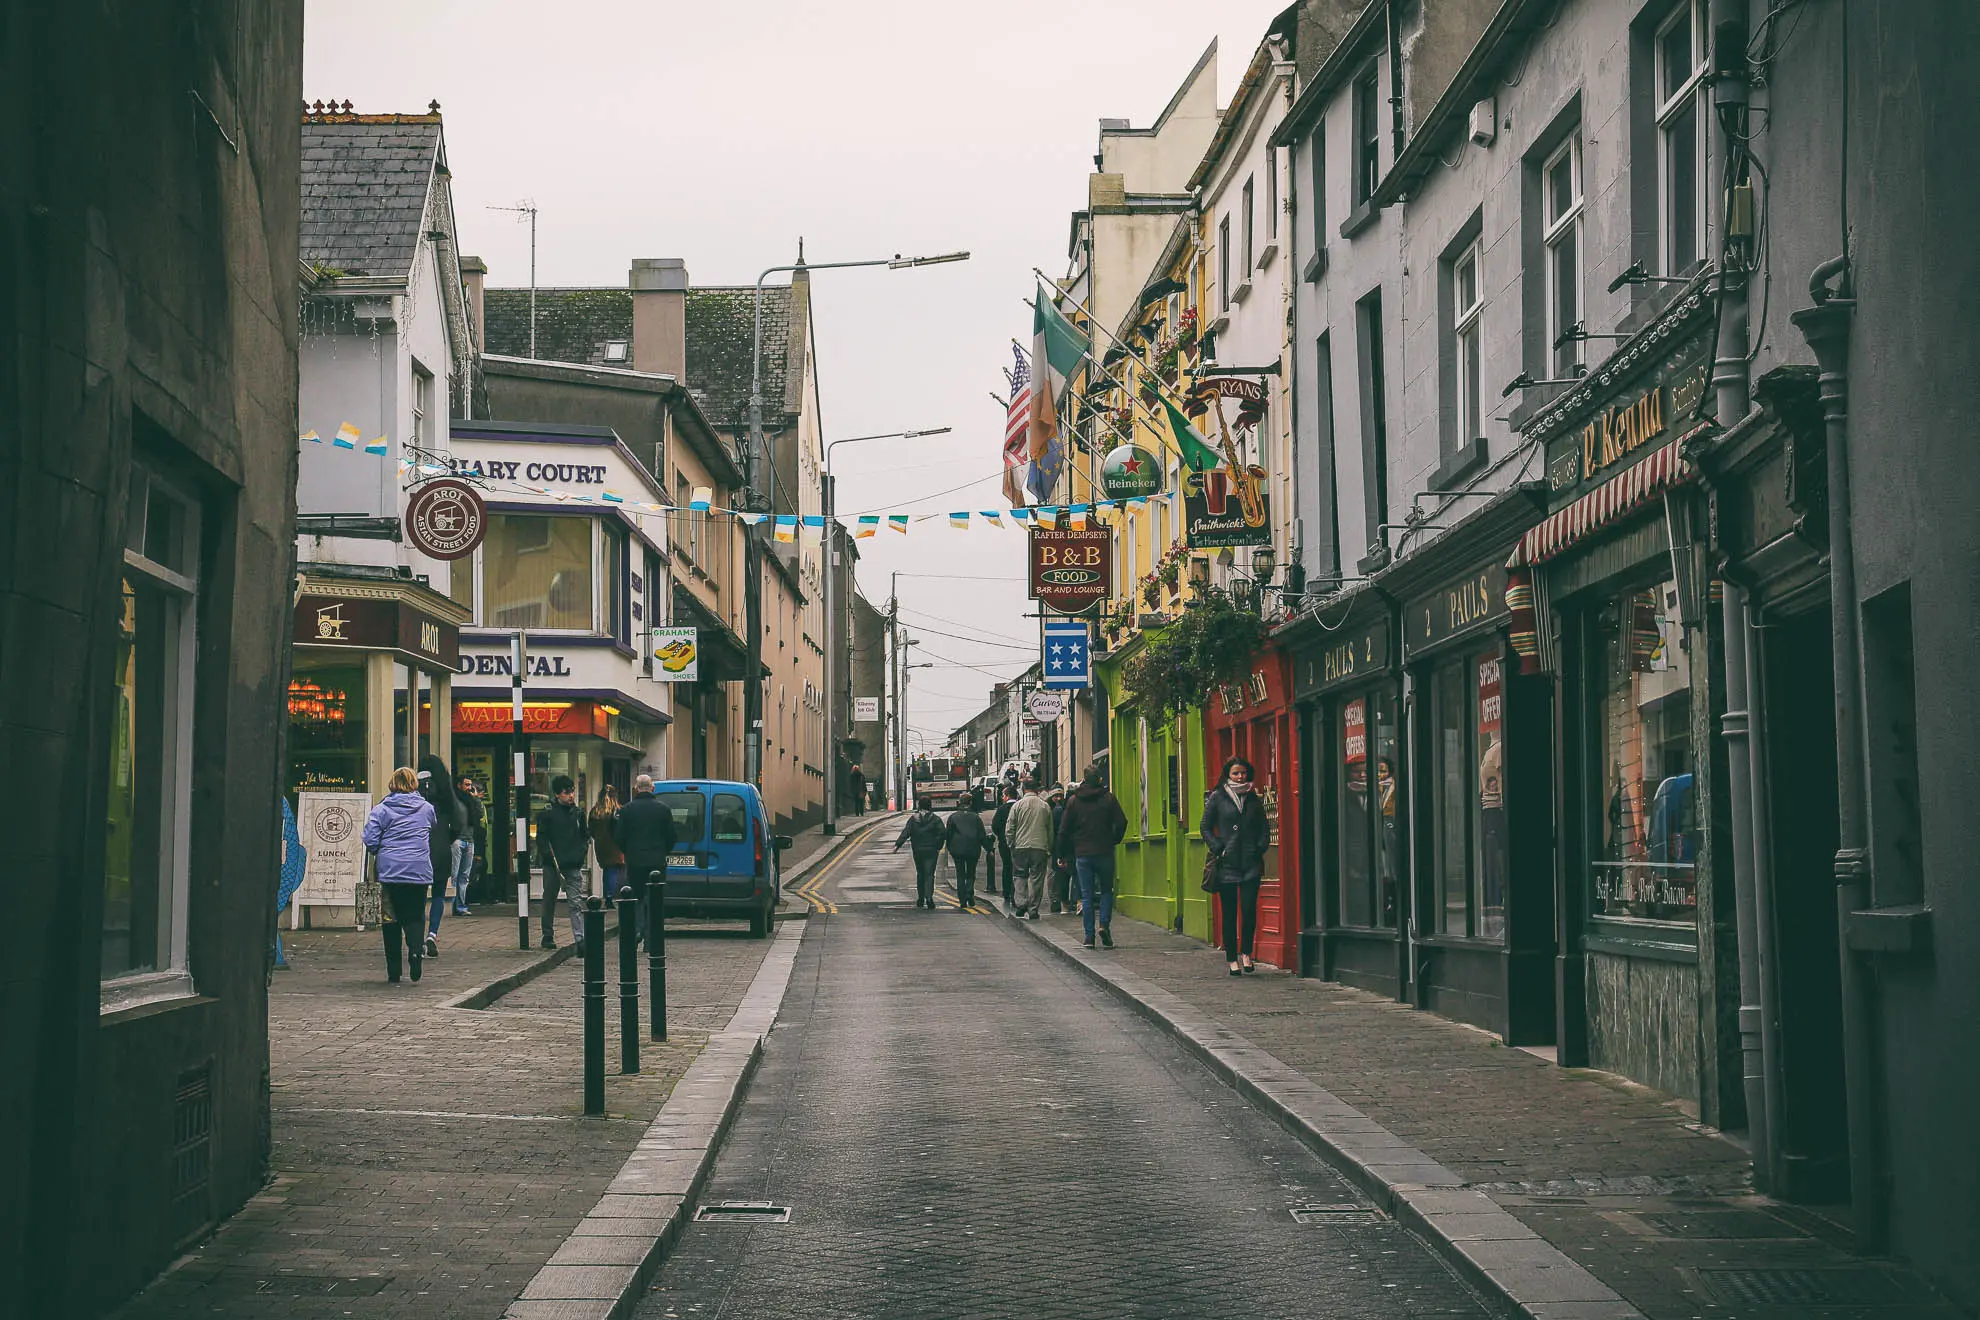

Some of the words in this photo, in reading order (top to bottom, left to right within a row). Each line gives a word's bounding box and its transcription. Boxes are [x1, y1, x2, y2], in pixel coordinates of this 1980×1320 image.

[1219, 380, 1262, 400] RYANS
[1601, 386, 1662, 469] Kenna
[526, 462, 607, 484] COURT
[1108, 479, 1156, 489] Heineken
[433, 490, 463, 502] AROI
[418, 515, 433, 542] ASIAN
[432, 538, 464, 549] STREET
[464, 515, 477, 539] FOOD
[1034, 531, 1065, 540] RAFTER
[1067, 531, 1108, 540] DEMPSEYS
[1190, 518, 1245, 535] Smithwick's
[1040, 546, 1058, 566] B
[1062, 547, 1081, 567] &
[1083, 546, 1101, 566] B
[1053, 571, 1088, 582] FOOD
[1036, 586, 1052, 595] BAR
[1053, 586, 1072, 594] AND
[1073, 586, 1105, 594] LOUNGE
[1450, 575, 1488, 629] PAULS
[421, 621, 439, 654] AROI
[653, 629, 696, 637] GRAHAMS
[458, 655, 571, 677] DENTAL
[1325, 640, 1355, 682] PAULS
[1031, 698, 1061, 708] Curves
